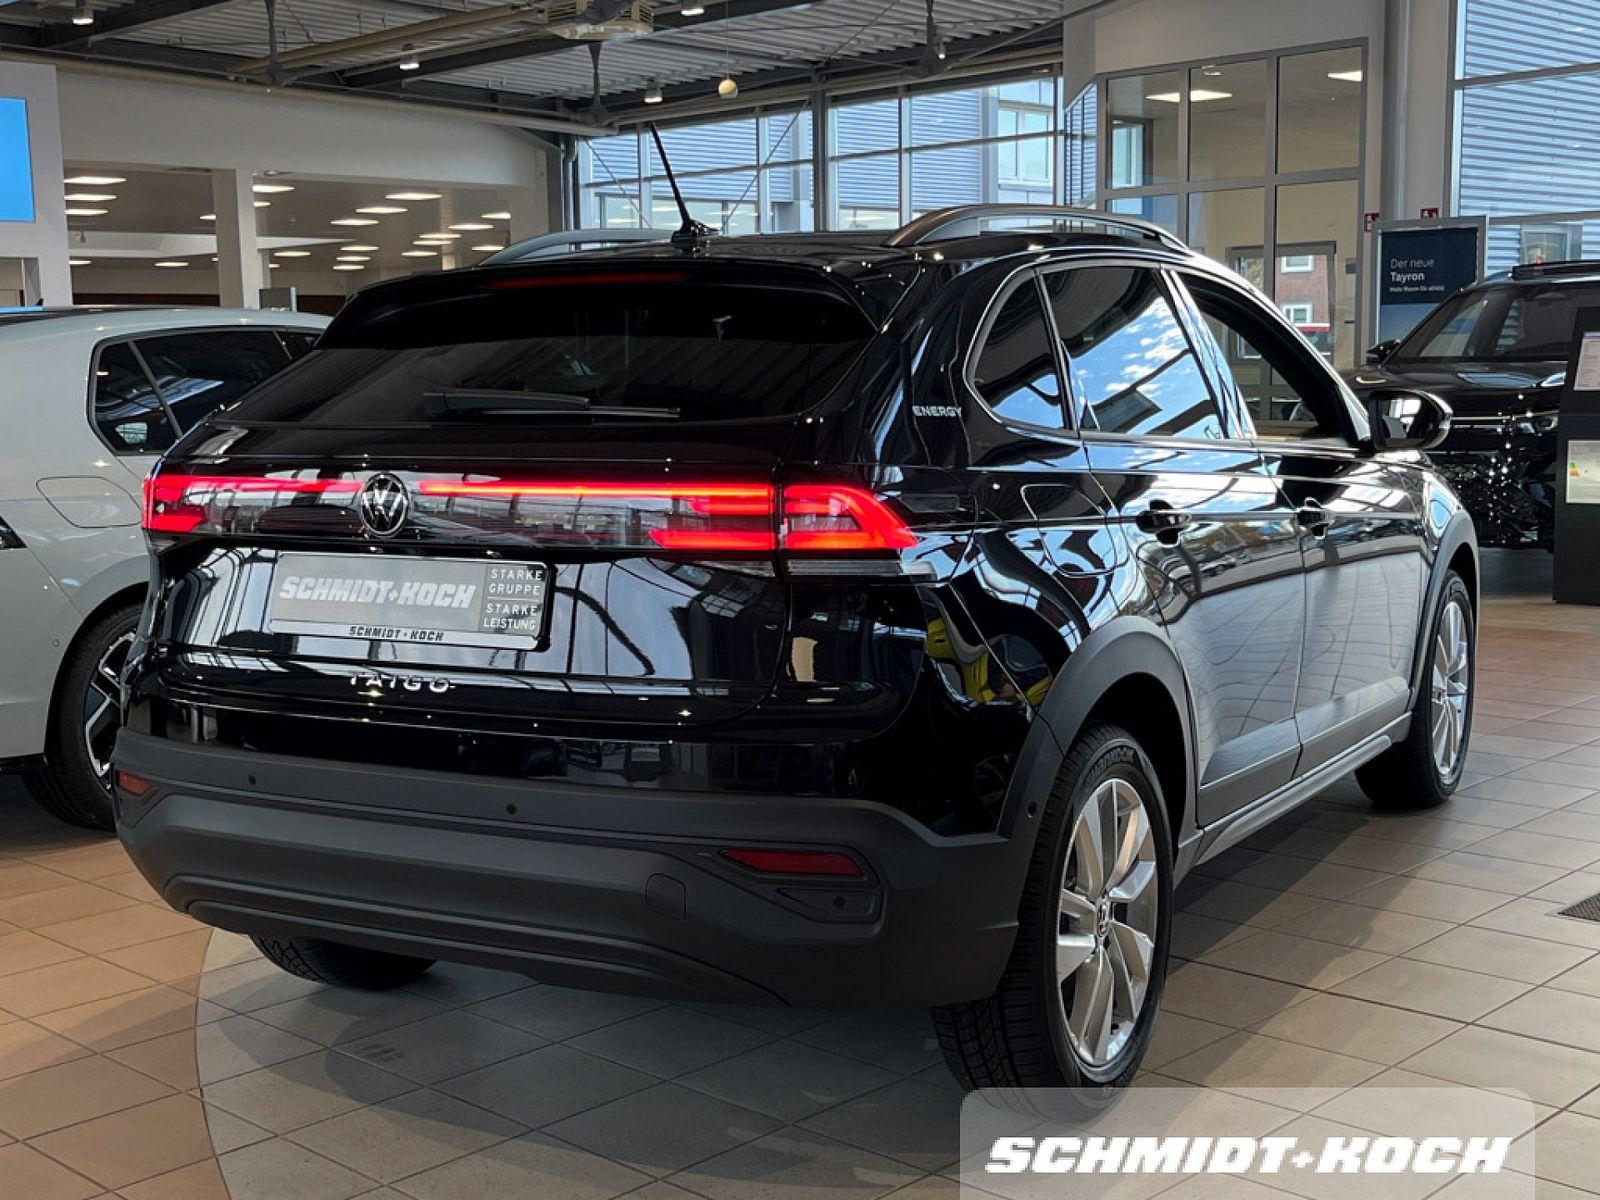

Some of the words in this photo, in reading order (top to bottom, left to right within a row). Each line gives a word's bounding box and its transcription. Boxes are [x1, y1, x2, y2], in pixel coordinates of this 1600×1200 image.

[1390, 258, 1408, 269] Der
[1410, 258, 1435, 268] neue
[1390, 271, 1425, 284] Tayron
[912, 405, 962, 417] ENERGY
[490, 568, 543, 581] STARKE
[488, 582, 541, 596] GRUPPE
[486, 602, 538, 617] STARKE
[483, 616, 537, 631] LEISTUNG
